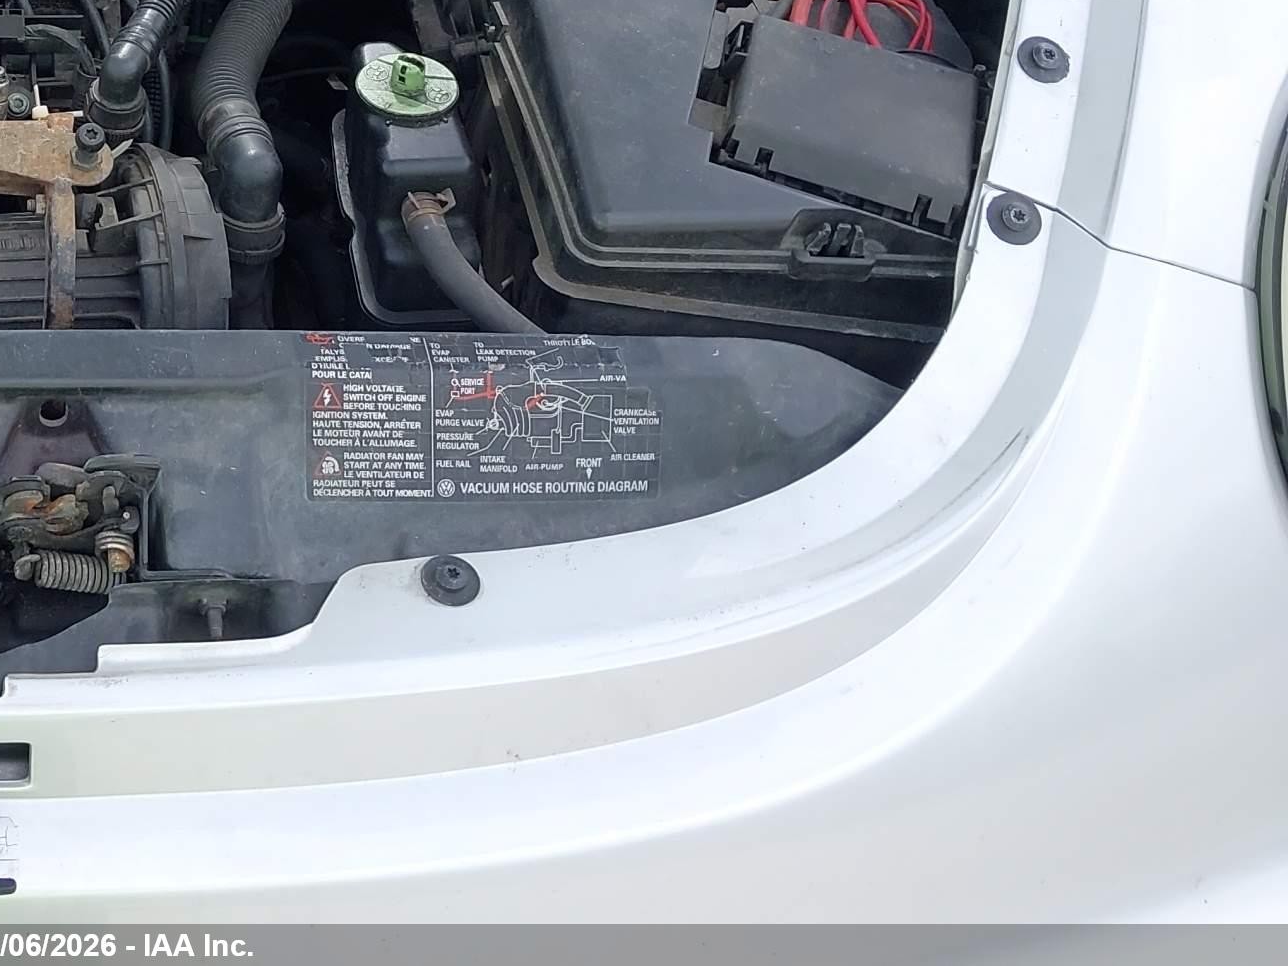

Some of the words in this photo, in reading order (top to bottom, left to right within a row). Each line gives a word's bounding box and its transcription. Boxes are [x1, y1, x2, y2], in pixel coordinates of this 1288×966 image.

[461, 378, 484, 386] SERVICE
[352, 412, 388, 420] SYSTEM.
[384, 418, 422, 429] ARRÊTER
[354, 436, 360, 447] À
[363, 439, 417, 447] L'ALLUMAGE.
[576, 458, 602, 468] FRONT
[313, 487, 364, 497] DÉCLENCHER
[460, 482, 510, 494] VACUUM
[512, 482, 543, 494] HOSE
[545, 481, 595, 493] ROUTING
[597, 480, 648, 492] DIAGRAM
